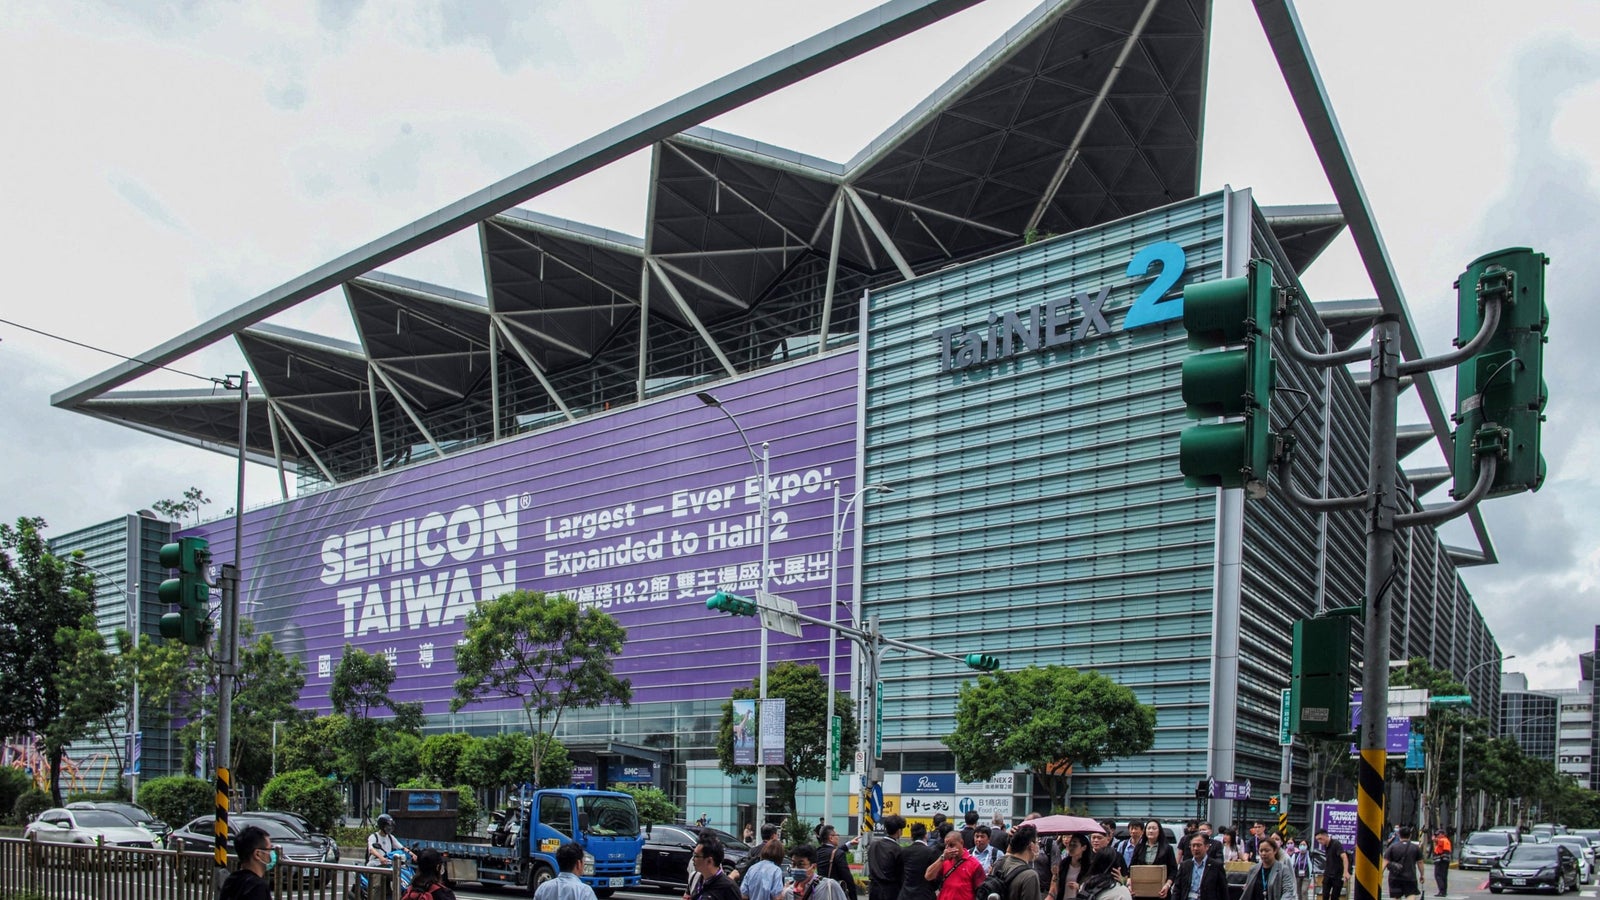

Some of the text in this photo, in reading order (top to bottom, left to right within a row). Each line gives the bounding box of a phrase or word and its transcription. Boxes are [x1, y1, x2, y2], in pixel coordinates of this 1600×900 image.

[932, 241, 1187, 372] TaiNEX 2
[545, 502, 636, 541] Largest
[671, 488, 736, 518] Ever
[744, 466, 833, 504] Expo:
[544, 511, 789, 577] Expanded to Hall 2
[336, 559, 517, 639] TAIWAN
